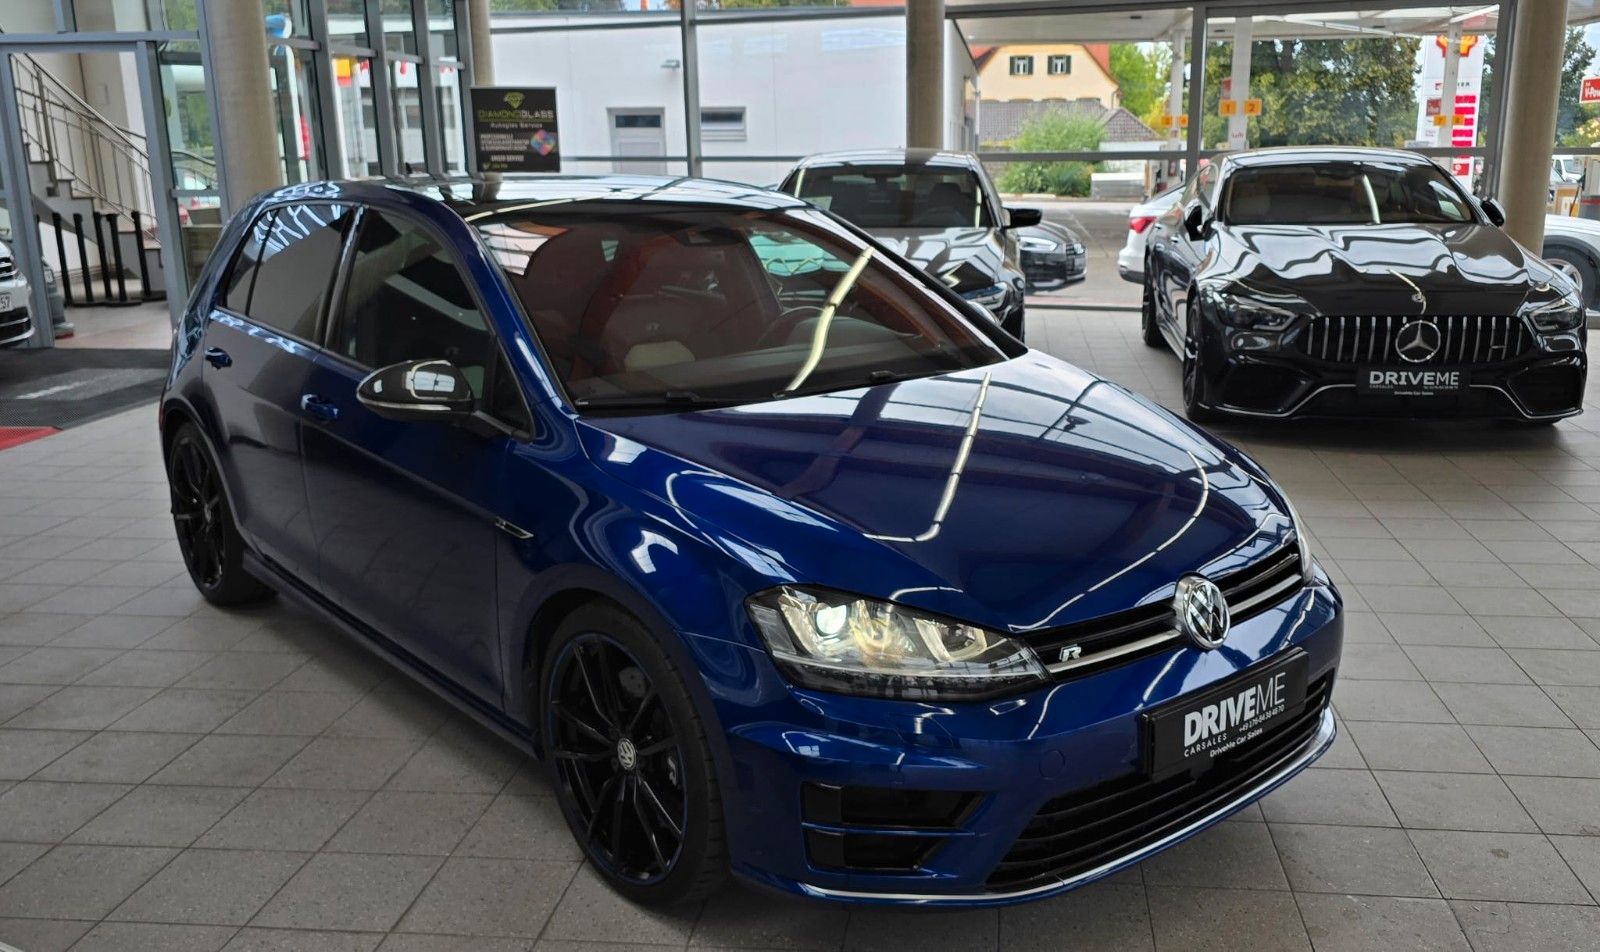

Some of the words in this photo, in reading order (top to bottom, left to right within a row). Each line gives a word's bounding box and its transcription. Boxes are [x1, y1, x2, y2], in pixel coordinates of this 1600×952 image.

[1369, 371, 1460, 385] DRIVEME
[1059, 644, 1082, 662] R
[1184, 672, 1287, 747] DRIVEME
[1184, 732, 1227, 757] CARSALES
[1236, 735, 1247, 745] Car
